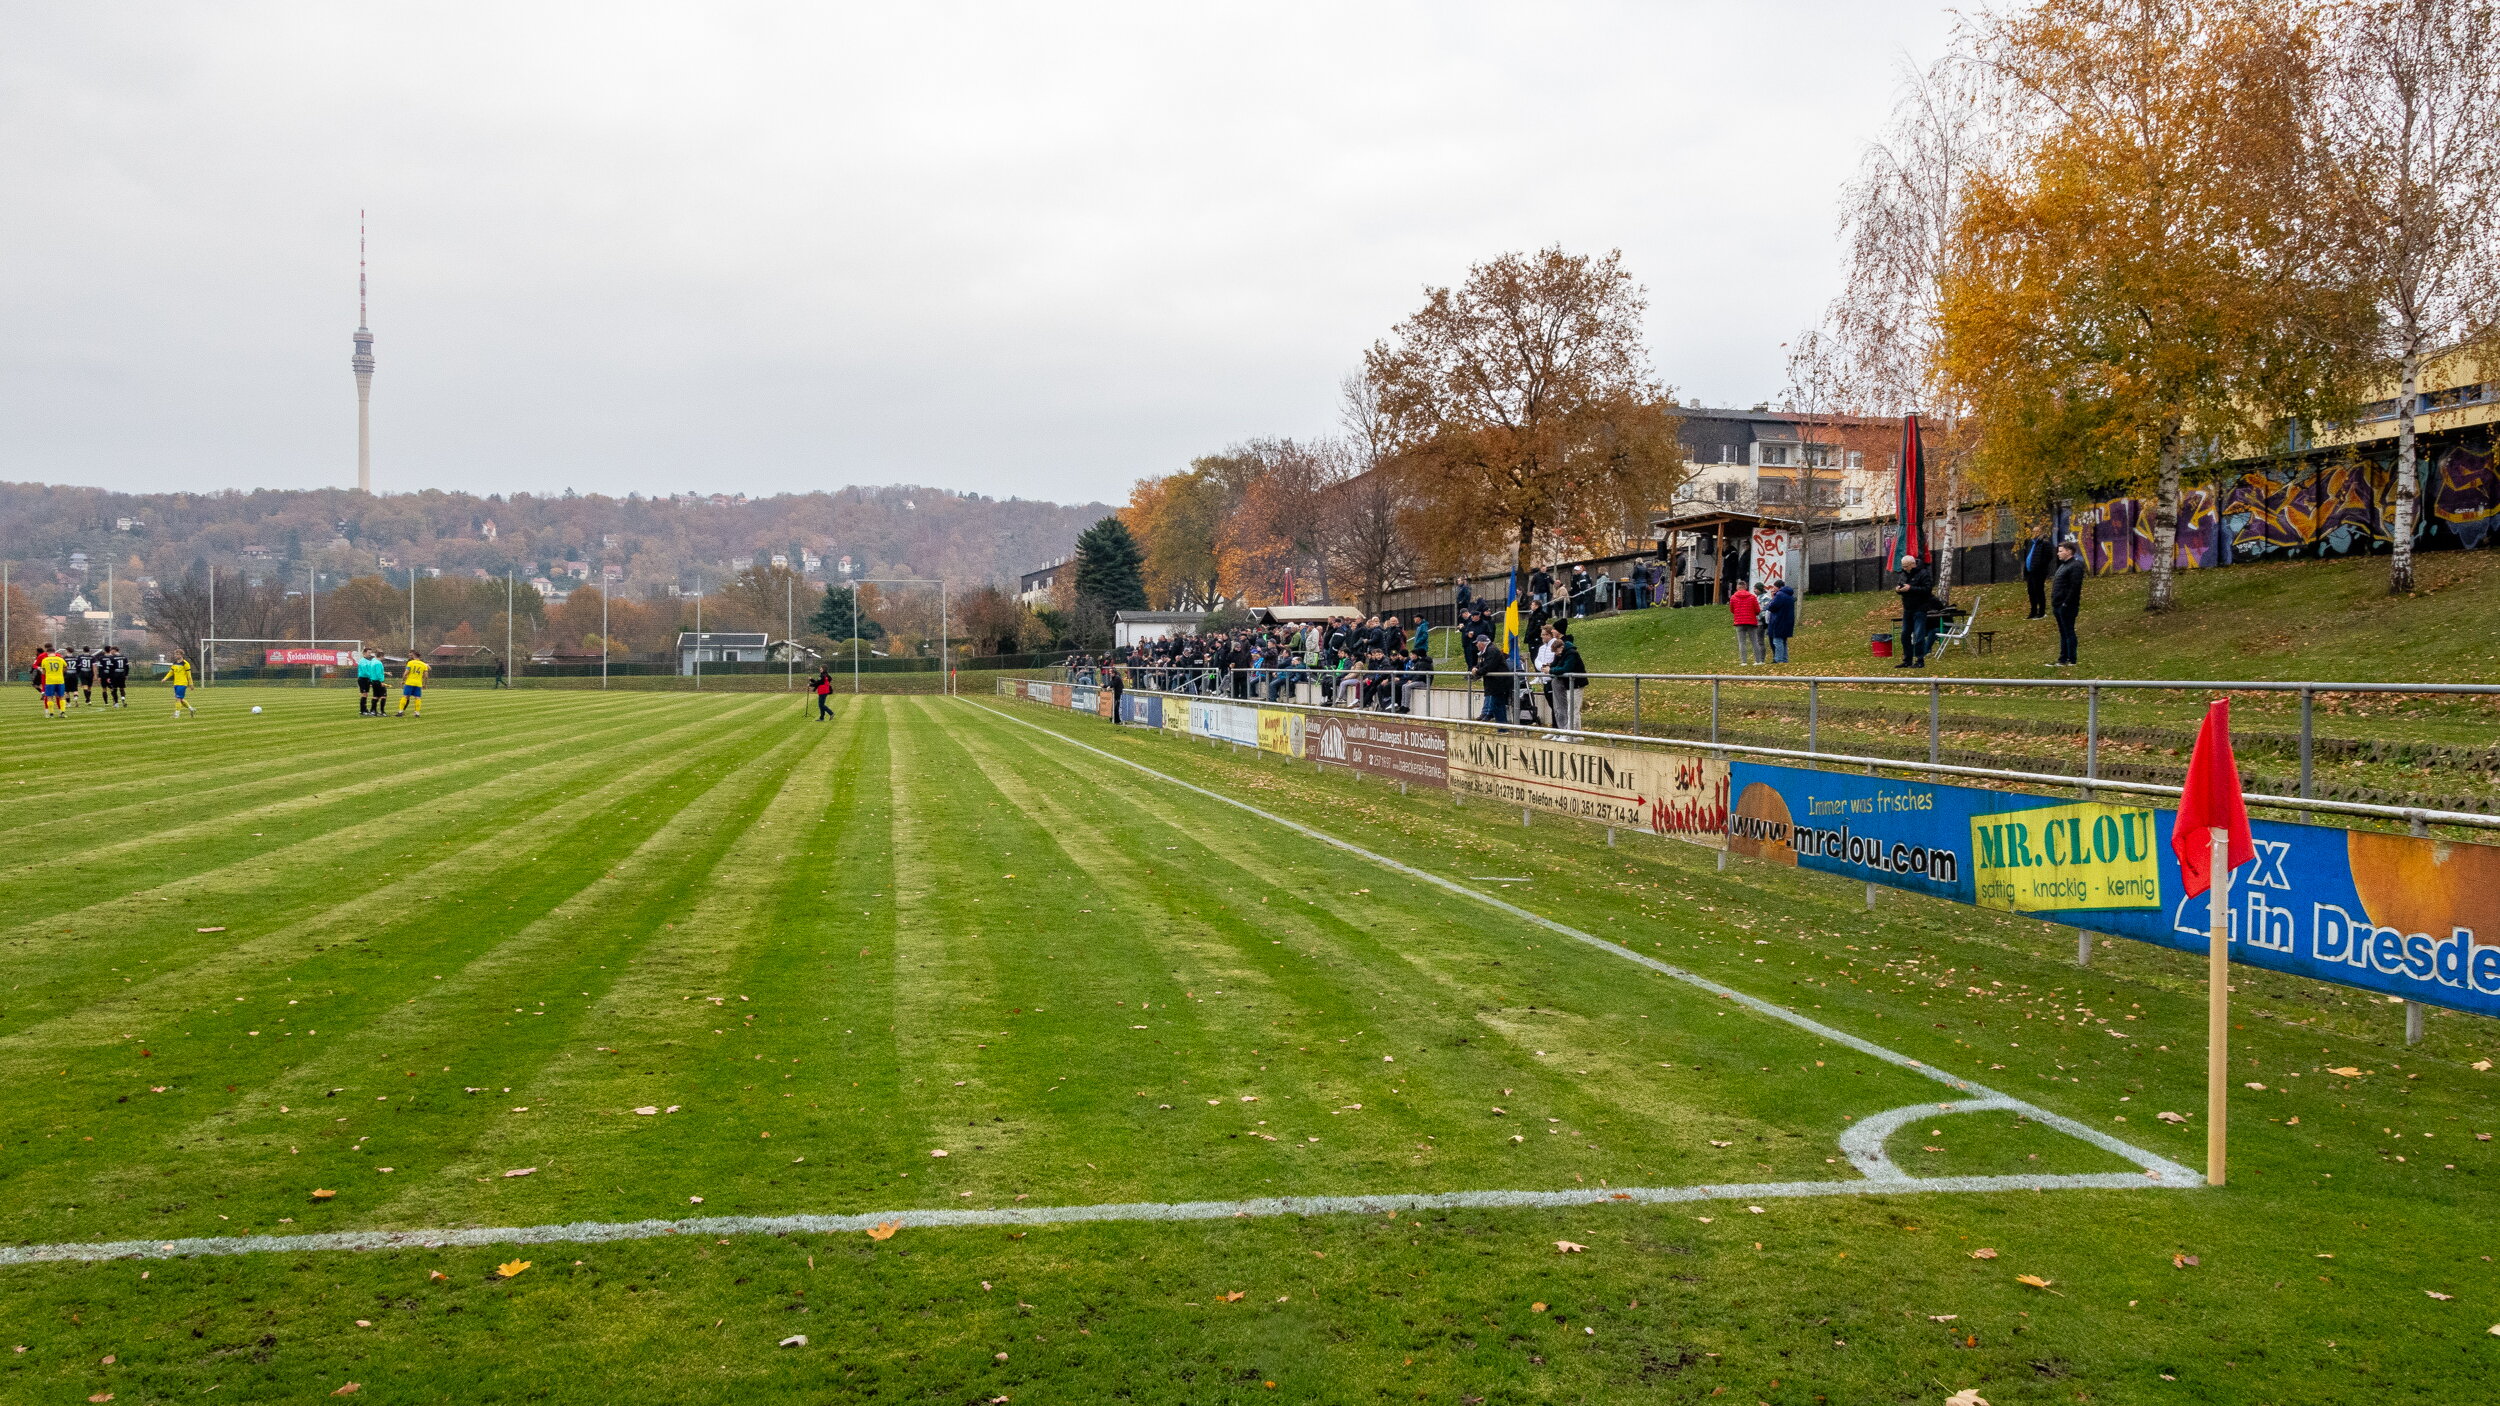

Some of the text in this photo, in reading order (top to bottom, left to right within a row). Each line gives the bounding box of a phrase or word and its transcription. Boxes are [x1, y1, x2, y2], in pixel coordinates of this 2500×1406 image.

[49, 662, 59, 672] 19
[67, 660, 77, 670] 12
[82, 659, 91, 668] 91
[117, 660, 124, 669] 11
[412, 665, 422, 676] 14
[1404, 730, 1409, 746] &
[1419, 732, 1445, 751] Südhöhe
[1495, 783, 1514, 799] 01279
[1527, 789, 1553, 807] Telefon
[1554, 795, 1568, 811] +49
[1569, 797, 1579, 816] (0)
[1581, 800, 1594, 816] 351
[1596, 802, 1612, 820] 257
[1614, 806, 1626, 823] 14
[1627, 808, 1639, 824] 34
[1807, 790, 1933, 816] Immer was frisches
[1730, 812, 1958, 883] www.mrclou.com
[1977, 809, 2151, 870] MR.CLOU
[1981, 879, 2015, 902] saftig
[2032, 876, 2087, 901] knackig
[2106, 873, 2155, 900] kernig
[2247, 891, 2294, 953] in
